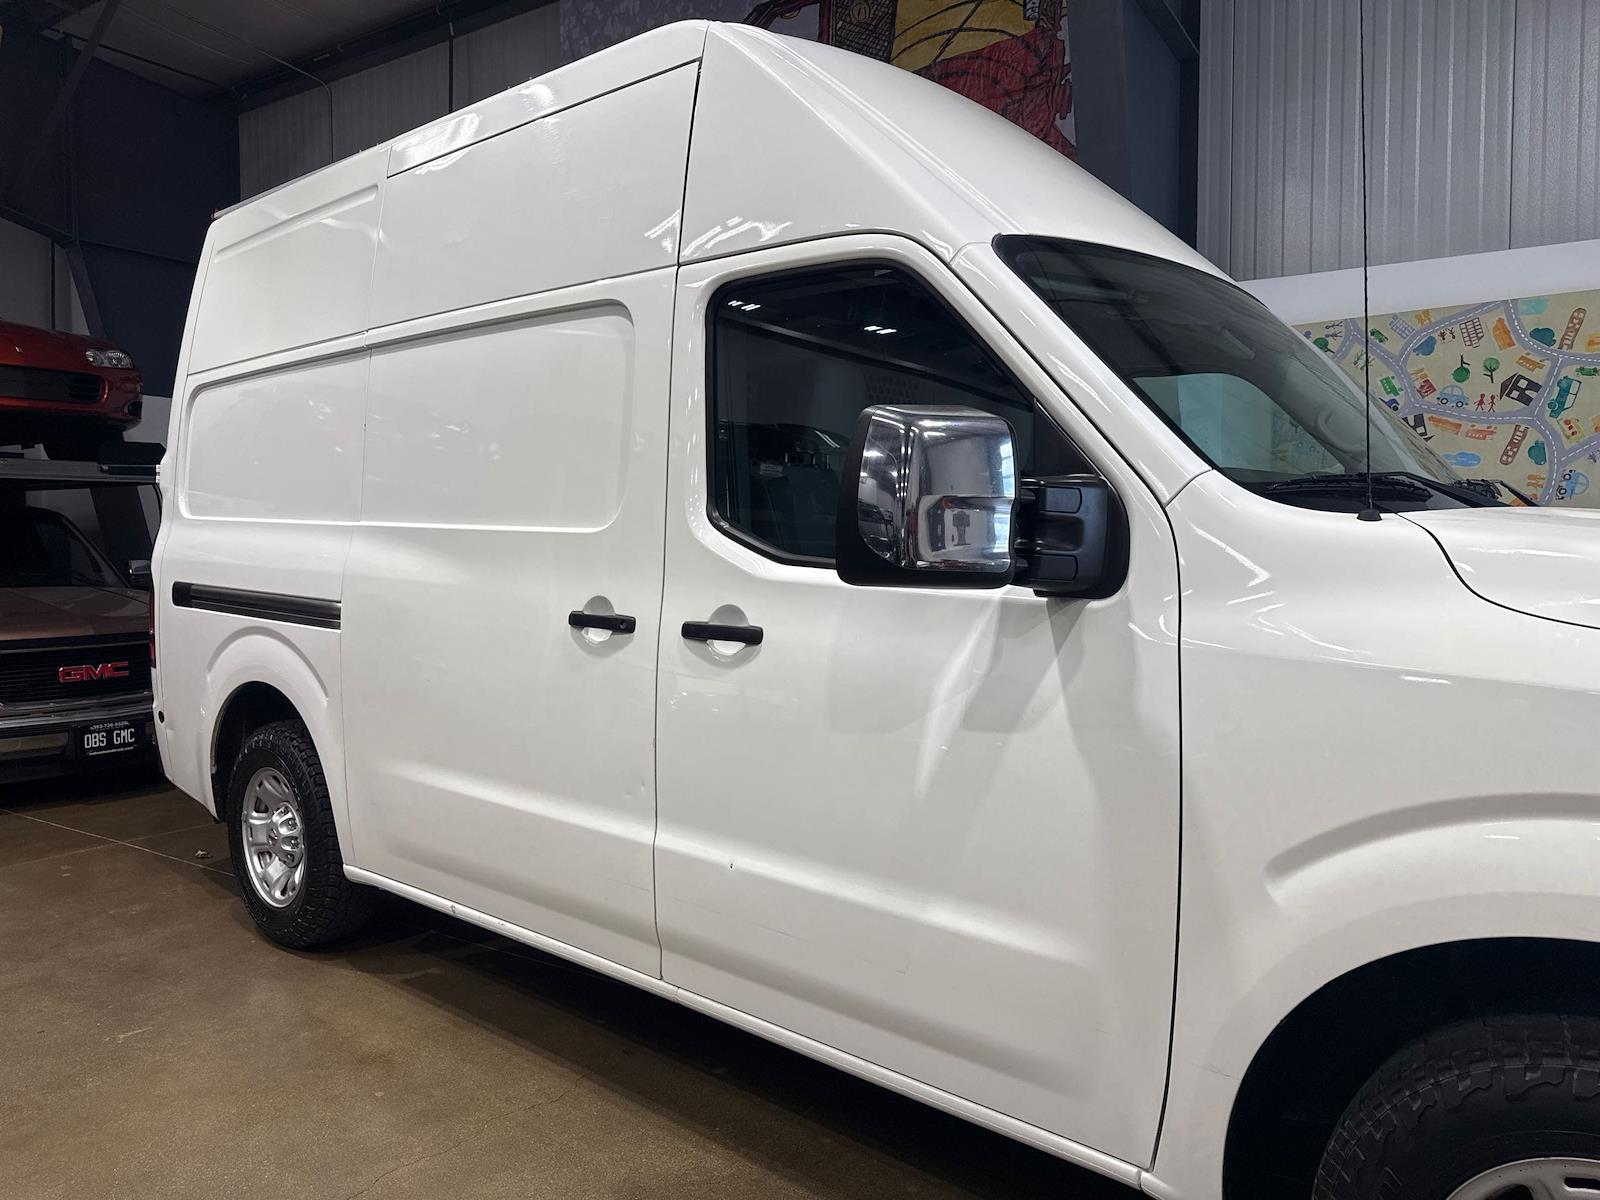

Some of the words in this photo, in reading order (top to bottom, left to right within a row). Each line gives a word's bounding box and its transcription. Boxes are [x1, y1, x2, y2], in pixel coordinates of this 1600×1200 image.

[58, 661, 129, 683] GMC
[84, 732, 107, 749] OBS
[113, 728, 135, 745] GMC
